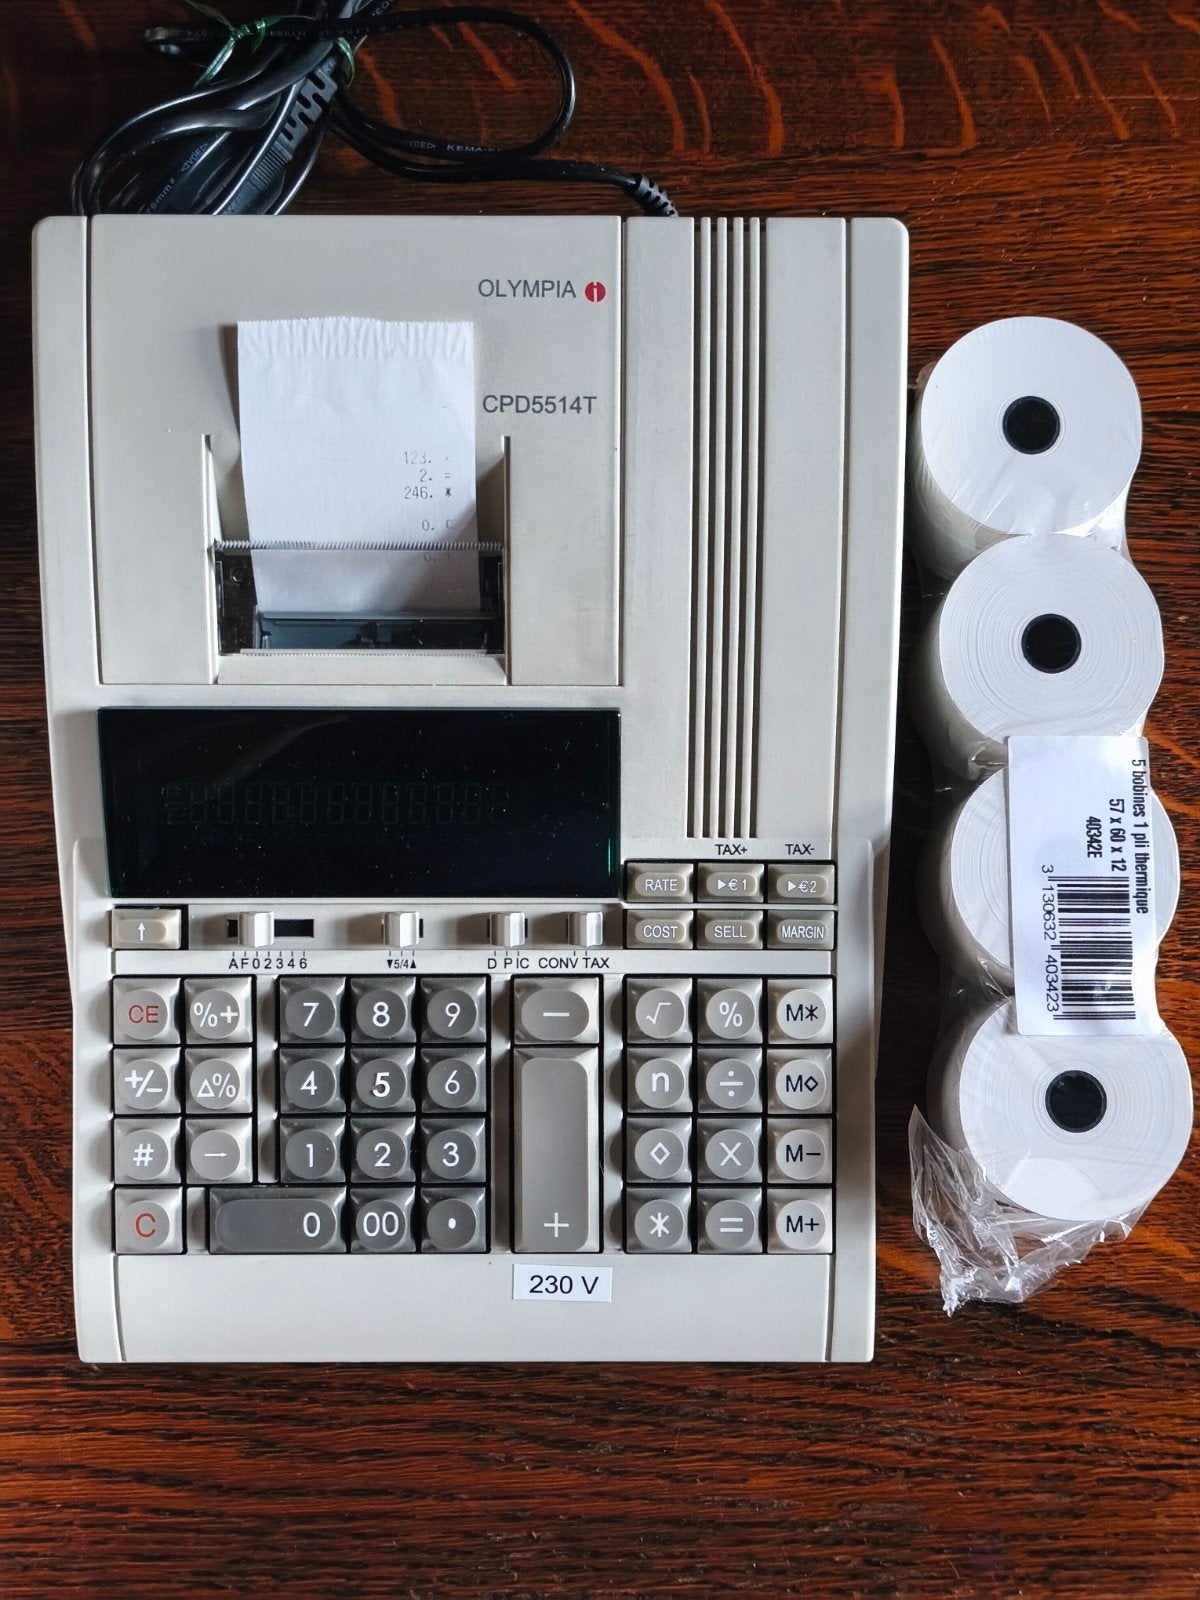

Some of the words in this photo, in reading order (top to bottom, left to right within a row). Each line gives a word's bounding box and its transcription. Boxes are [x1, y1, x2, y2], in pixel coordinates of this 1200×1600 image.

[478, 279, 577, 299] OLYMPIA
[482, 394, 597, 414] CPD5514T
[404, 486, 434, 500] 246.
[1132, 759, 1147, 767] 5
[1132, 771, 1148, 817] bobines
[1109, 798, 1125, 813] 57
[1086, 816, 1103, 858] 40342E
[1109, 828, 1126, 842] 60
[1130, 833, 1150, 848] pli
[715, 844, 748, 856] TAX+
[785, 844, 815, 856] TAX-
[1041, 864, 1055, 874] 3
[1111, 857, 1127, 872] 12
[645, 879, 678, 892] RATE
[1132, 852, 1151, 914] thermique
[1042, 885, 1057, 941] 130632
[643, 925, 678, 939] COST
[714, 925, 748, 939] SELL
[781, 926, 825, 940] MARGIN
[538, 957, 579, 970] CONV
[582, 957, 610, 970] TAX
[1044, 954, 1060, 1012] 403423
[128, 1004, 159, 1024] CE
[303, 1002, 320, 1027] 7
[372, 1002, 391, 1027] 8
[445, 1002, 461, 1027] 9
[300, 1070, 318, 1096] 4
[372, 1072, 391, 1098] 5
[444, 1069, 461, 1096] 6
[651, 1071, 670, 1093] n
[305, 1143, 315, 1168] 1
[374, 1142, 392, 1168] 2
[442, 1142, 460, 1168] 3
[135, 1212, 157, 1238] C
[303, 1211, 321, 1238] 0
[363, 1211, 399, 1237] 00
[785, 1215, 820, 1234] M+
[529, 1273, 574, 1295] 230
[582, 1275, 600, 1295] V
